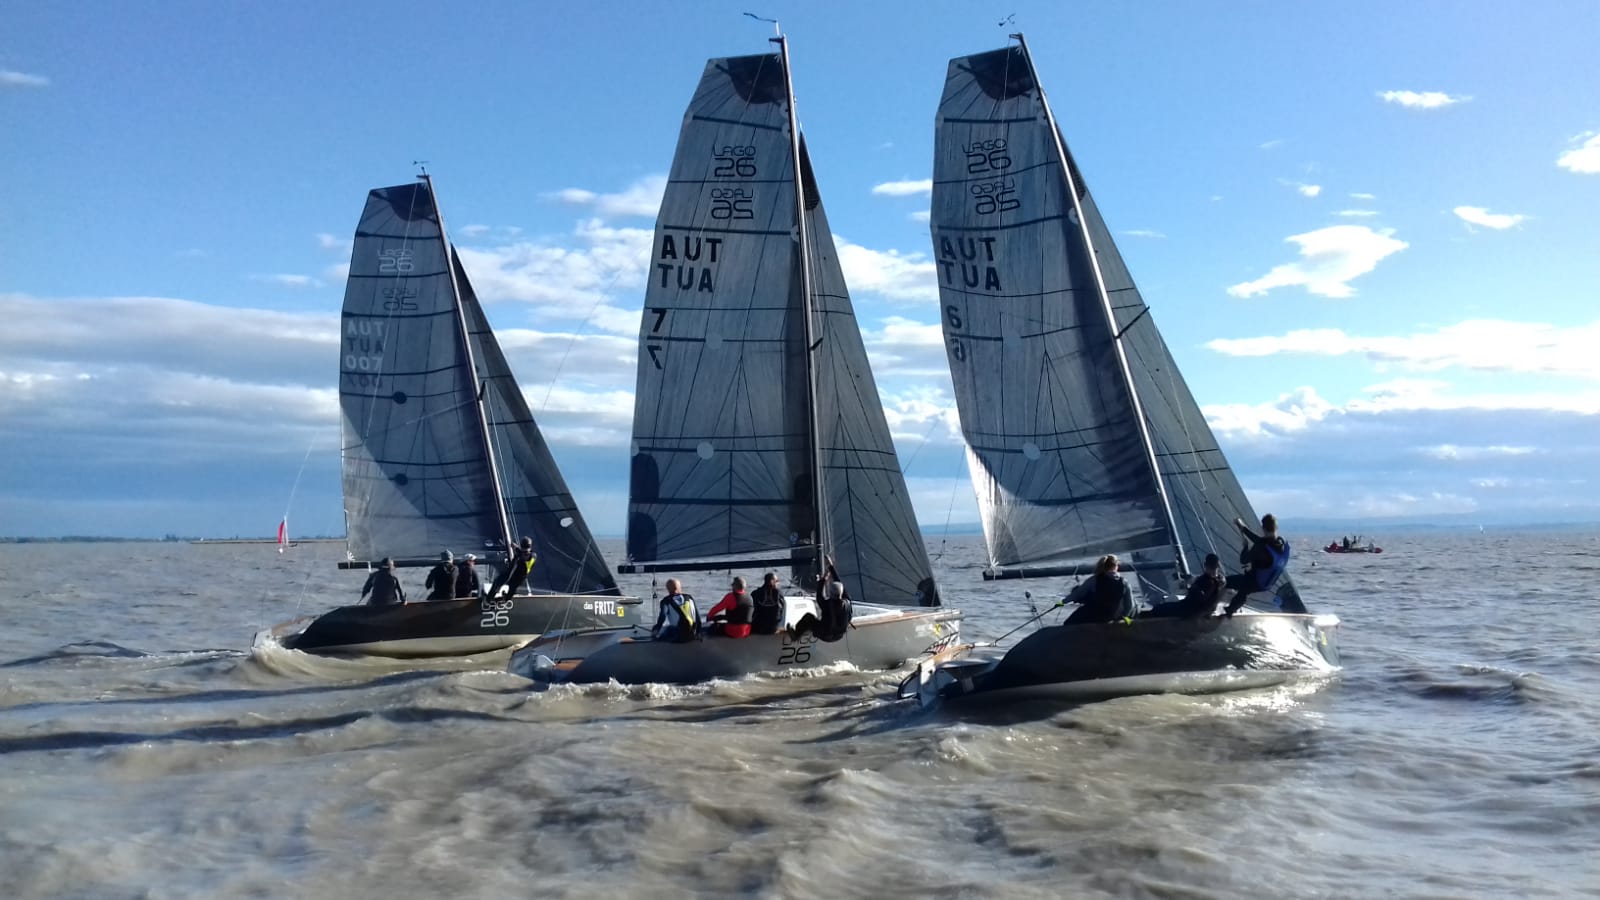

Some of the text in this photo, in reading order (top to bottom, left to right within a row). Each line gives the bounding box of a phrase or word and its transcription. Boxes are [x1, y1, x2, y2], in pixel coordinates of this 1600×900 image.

[713, 145, 757, 157] LAGO
[962, 138, 1007, 154] LAGO
[713, 157, 757, 178] 26
[966, 150, 1012, 174] 26
[660, 235, 723, 263] AUT
[939, 236, 996, 262] AUT
[379, 257, 415, 273] 26
[650, 308, 667, 333] 7
[946, 305, 963, 331] 6
[346, 320, 385, 337] AUT
[345, 355, 384, 371] 007
[594, 600, 616, 616] FRITZ
[480, 610, 510, 628] 26
[777, 646, 811, 665] 26
